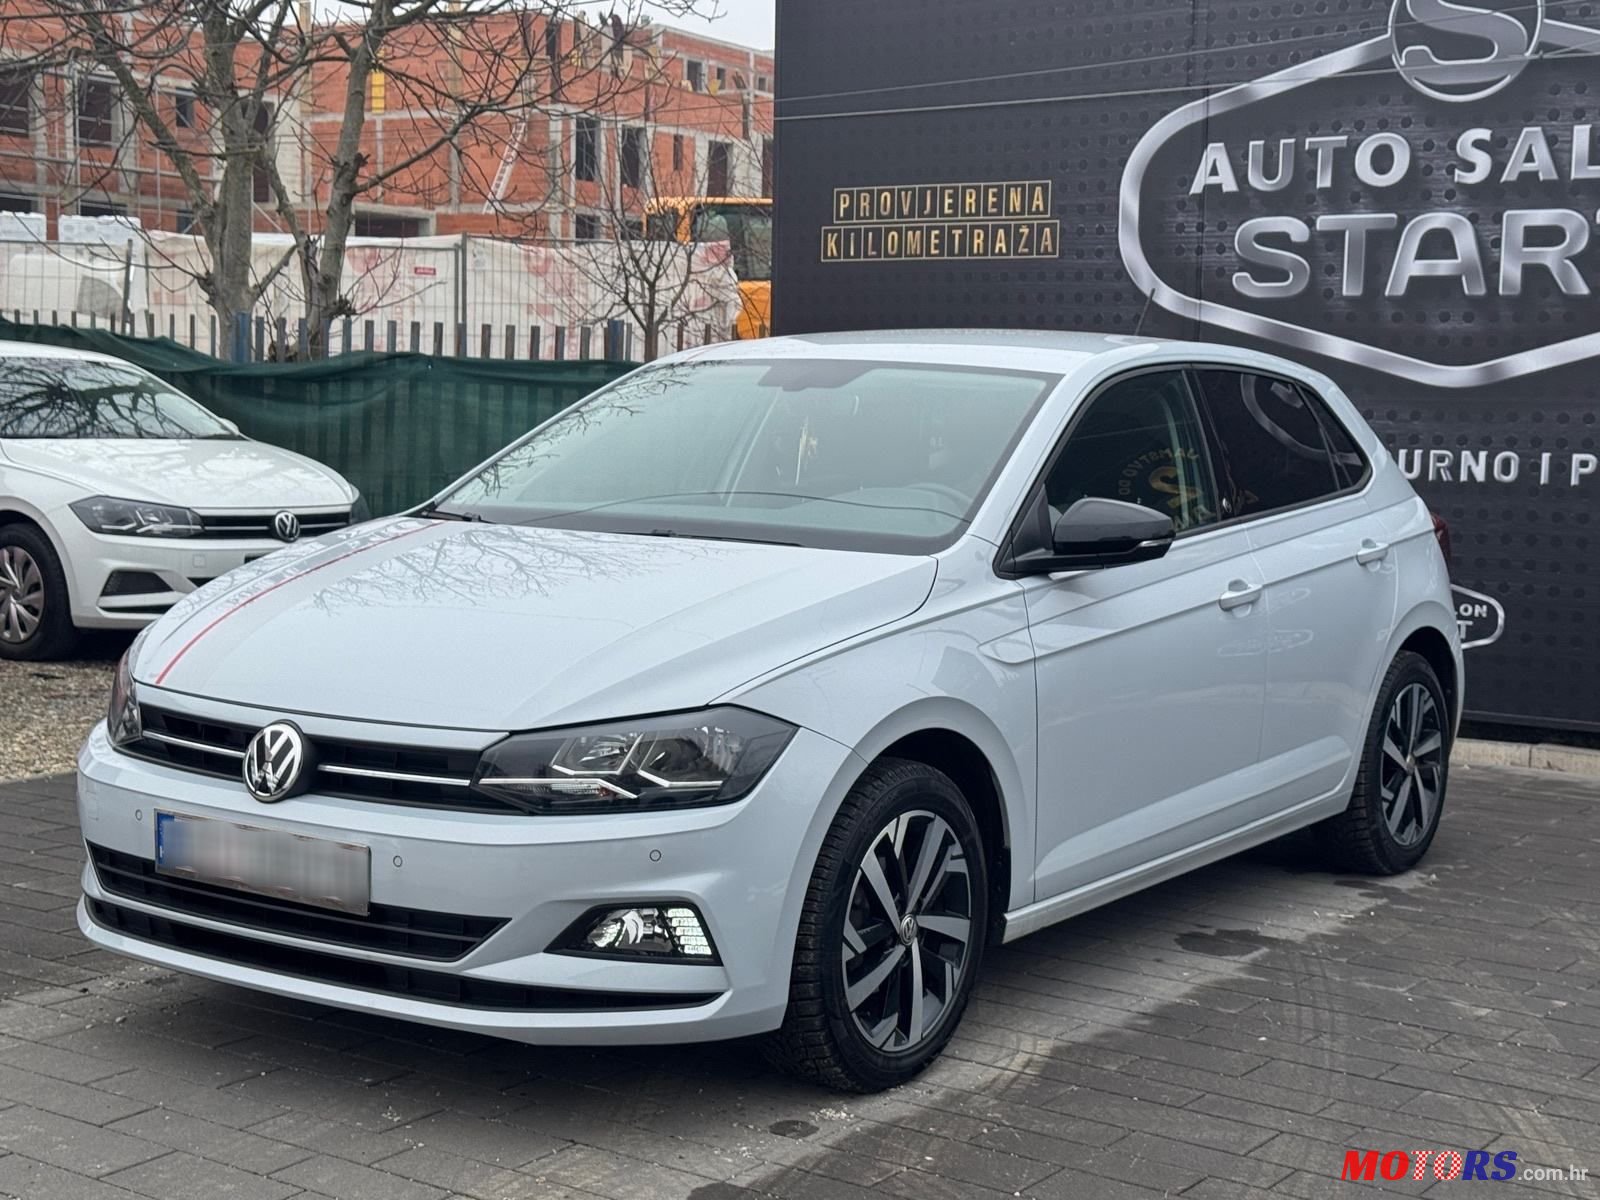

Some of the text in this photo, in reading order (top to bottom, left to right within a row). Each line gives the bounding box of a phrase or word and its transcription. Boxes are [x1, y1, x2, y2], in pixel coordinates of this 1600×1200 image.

[1189, 131, 1411, 196] AUTO
[839, 185, 1045, 218] PROVJERENA
[826, 224, 1054, 258] KILOMETRAŽA
[1540, 452, 1553, 486] I
